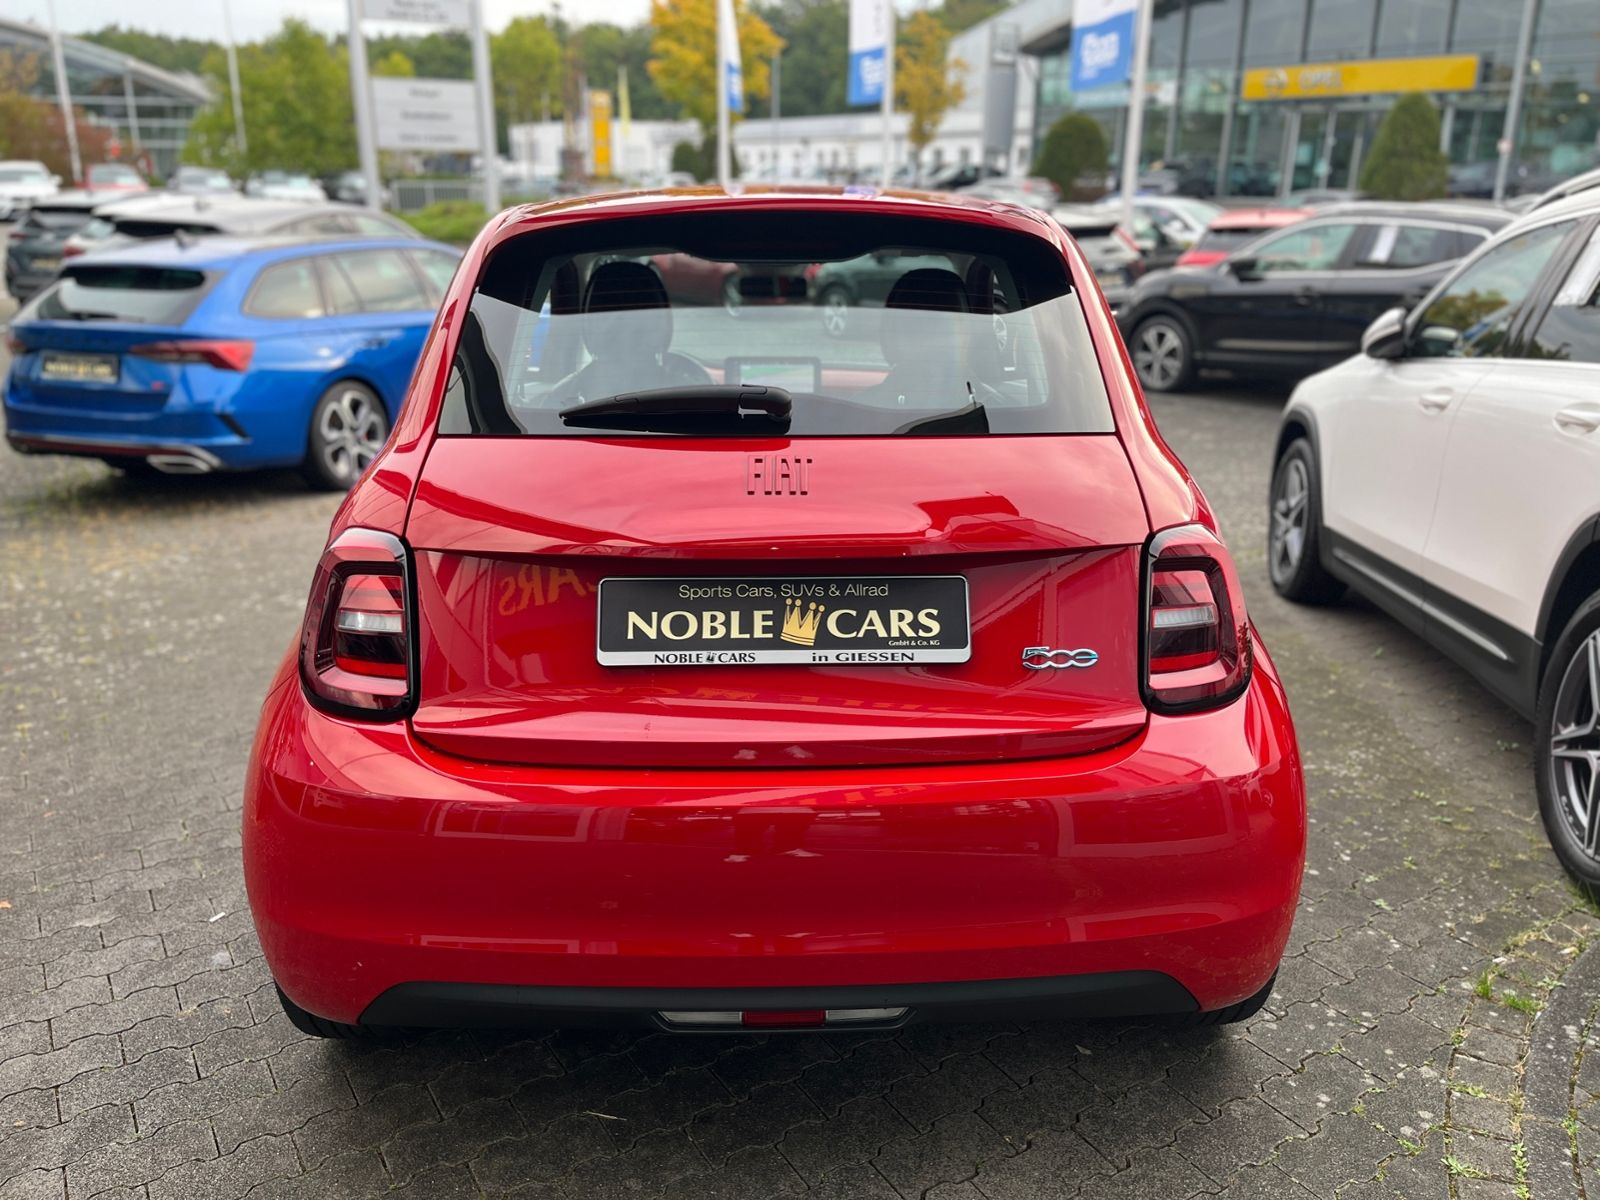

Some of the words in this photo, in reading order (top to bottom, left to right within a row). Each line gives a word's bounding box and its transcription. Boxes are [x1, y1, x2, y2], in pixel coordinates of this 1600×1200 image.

[746, 455, 813, 496] FIAT
[678, 584, 732, 600] Sports
[735, 584, 777, 599] Cars,
[780, 583, 825, 597] SUVs
[828, 584, 841, 596] &
[844, 583, 889, 597] Allrad
[626, 610, 774, 641] NOBLE
[826, 608, 942, 639] CARS
[654, 653, 703, 664] NOBLE
[718, 652, 756, 664] CARS
[812, 652, 829, 662] in
[835, 652, 915, 662] GIESSEN
[1022, 646, 1099, 669] 500
